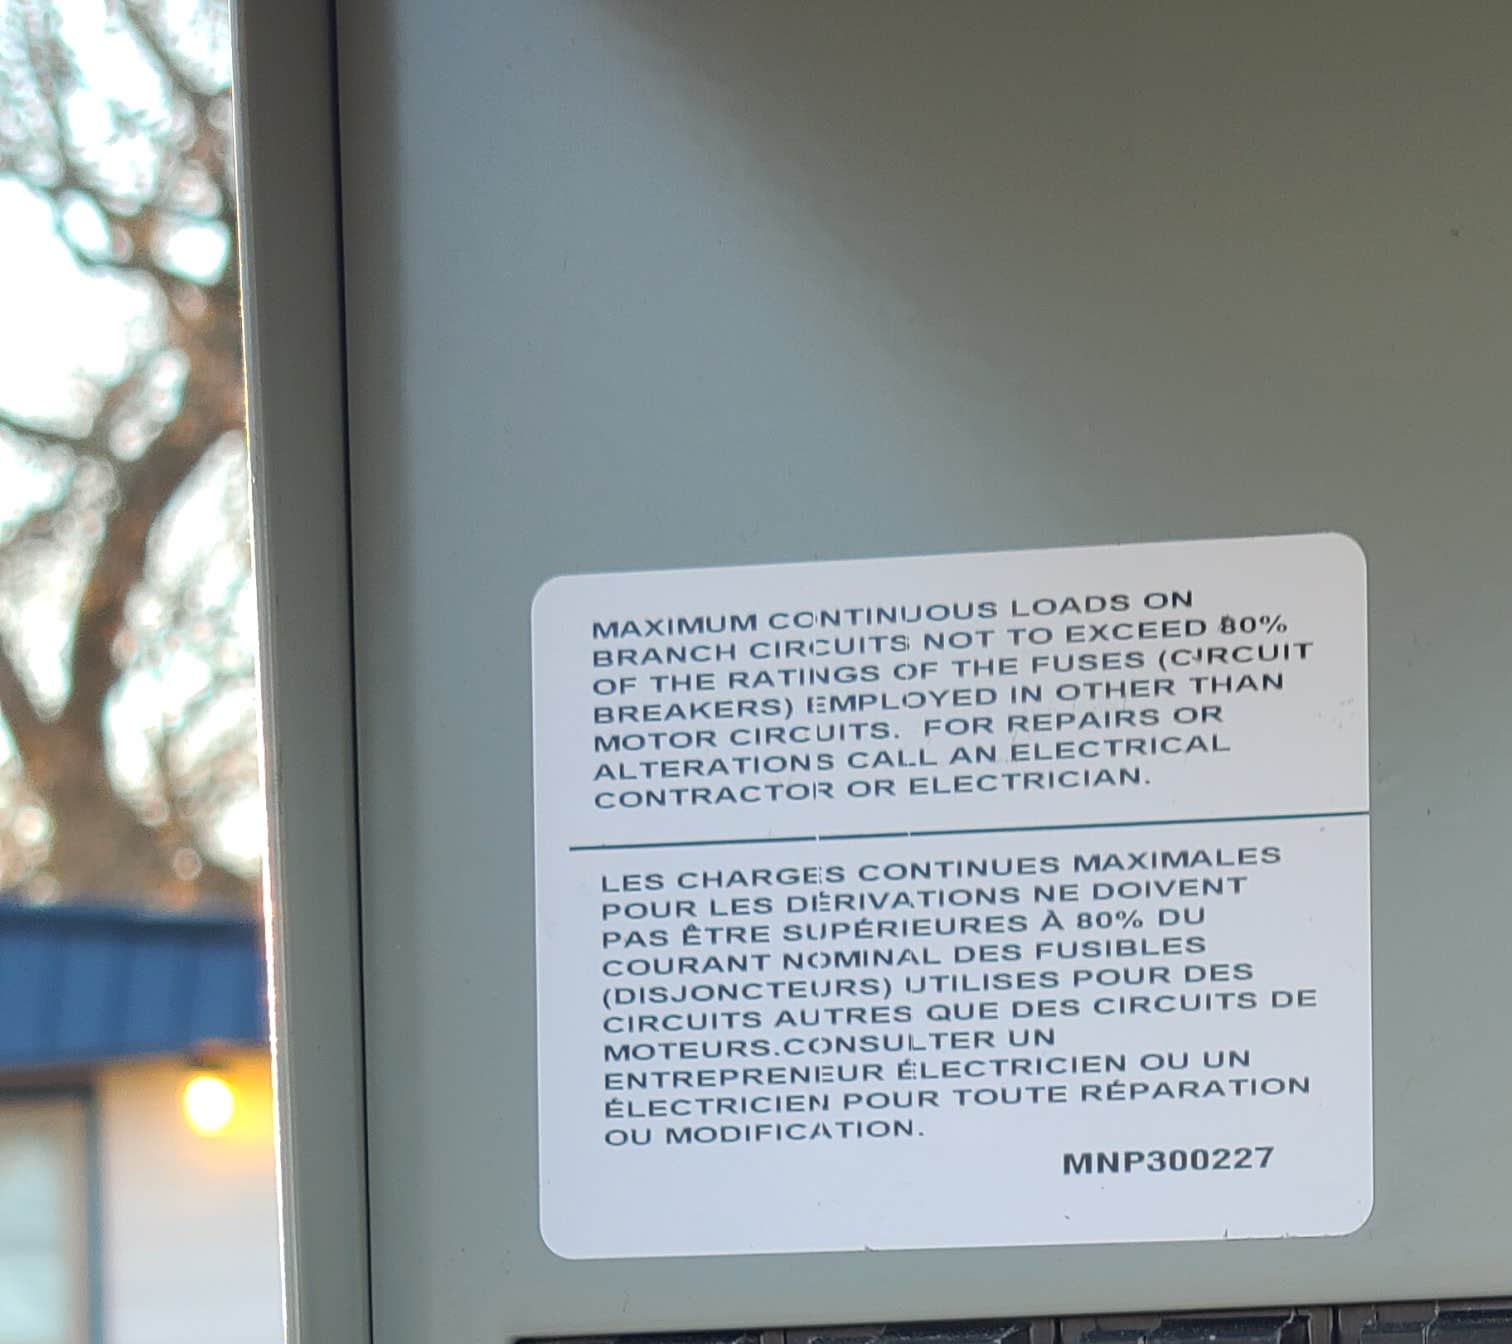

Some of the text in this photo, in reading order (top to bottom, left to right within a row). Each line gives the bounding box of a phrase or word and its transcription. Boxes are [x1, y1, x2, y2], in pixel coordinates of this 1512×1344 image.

[592, 590, 1193, 639] MAXIMUM CONTINUOUS LOADS ON
[592, 615, 1288, 668] BRANCH CIRCUITS NOT TO EXCEED 80%
[592, 642, 1314, 696] OF THE RATINGS OF THE FUSES (CIRCUIT
[593, 673, 1283, 724] BREAKERS) EMPLOYED IN OTHER THAN
[594, 705, 1223, 752] MOTOR CIRCUITS. FOR REPAIRS OR
[593, 734, 1231, 781] ALTERATIONS CALL AN ELECTRICAL
[594, 768, 1150, 809] CONTRACTOR OR ELECTRICIAN.
[601, 846, 1281, 893] LES CHARGES CONTINUES MAXIMALES
[1063, 1147, 1274, 1175] MNP300227
